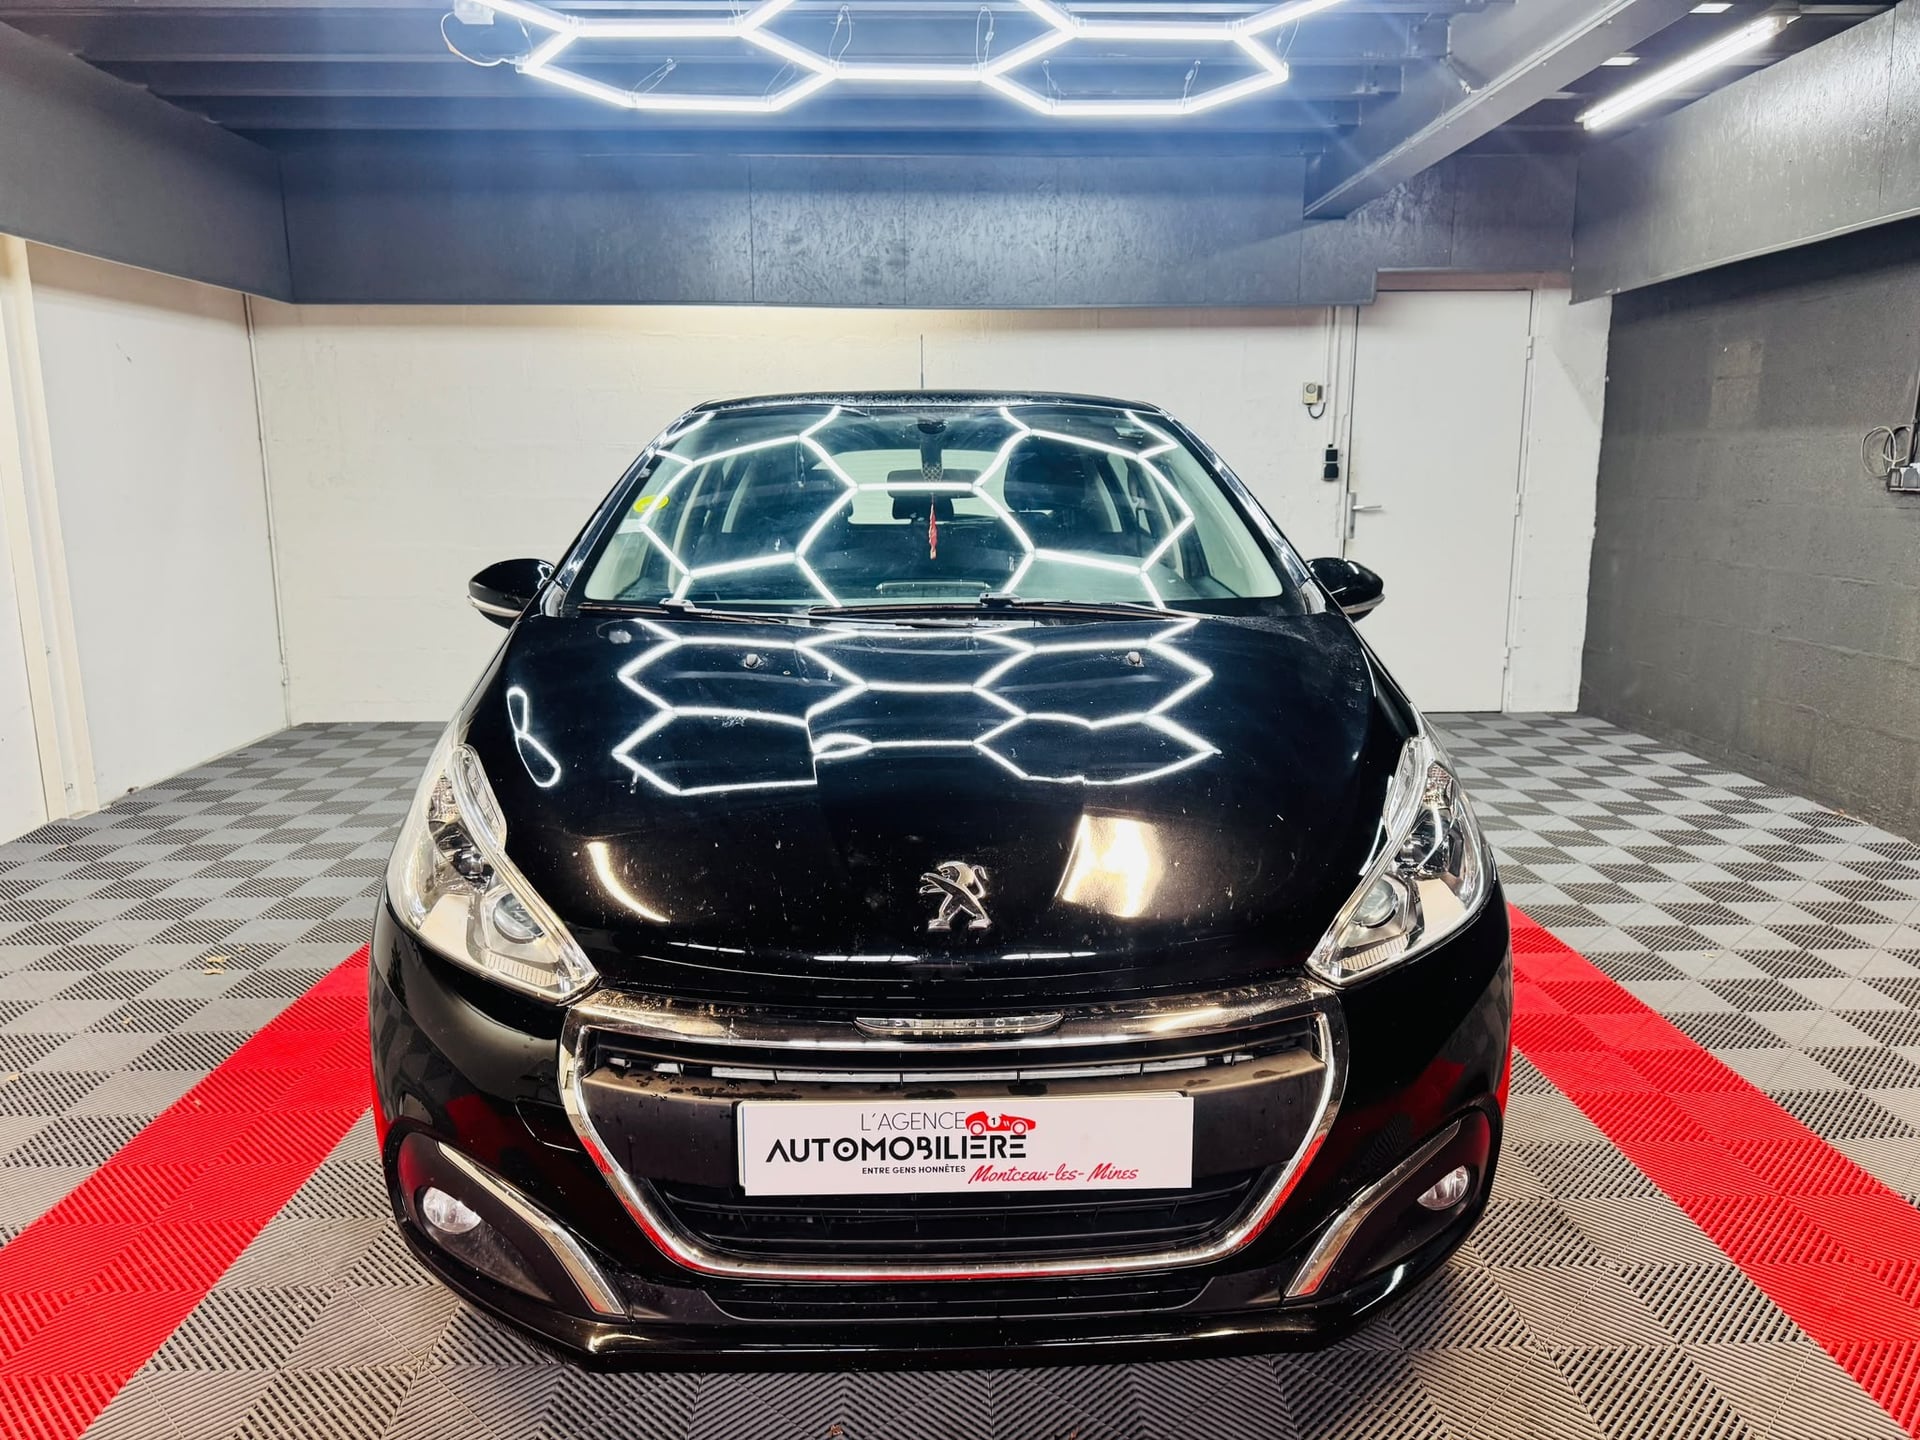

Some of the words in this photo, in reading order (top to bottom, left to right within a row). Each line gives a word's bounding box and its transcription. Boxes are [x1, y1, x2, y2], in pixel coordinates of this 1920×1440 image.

[861, 1111, 966, 1131] L'AGENCE
[862, 1167, 891, 1175] ENTRE
[892, 1166, 917, 1174] GENS
[918, 1164, 966, 1174] HONNÊTES
